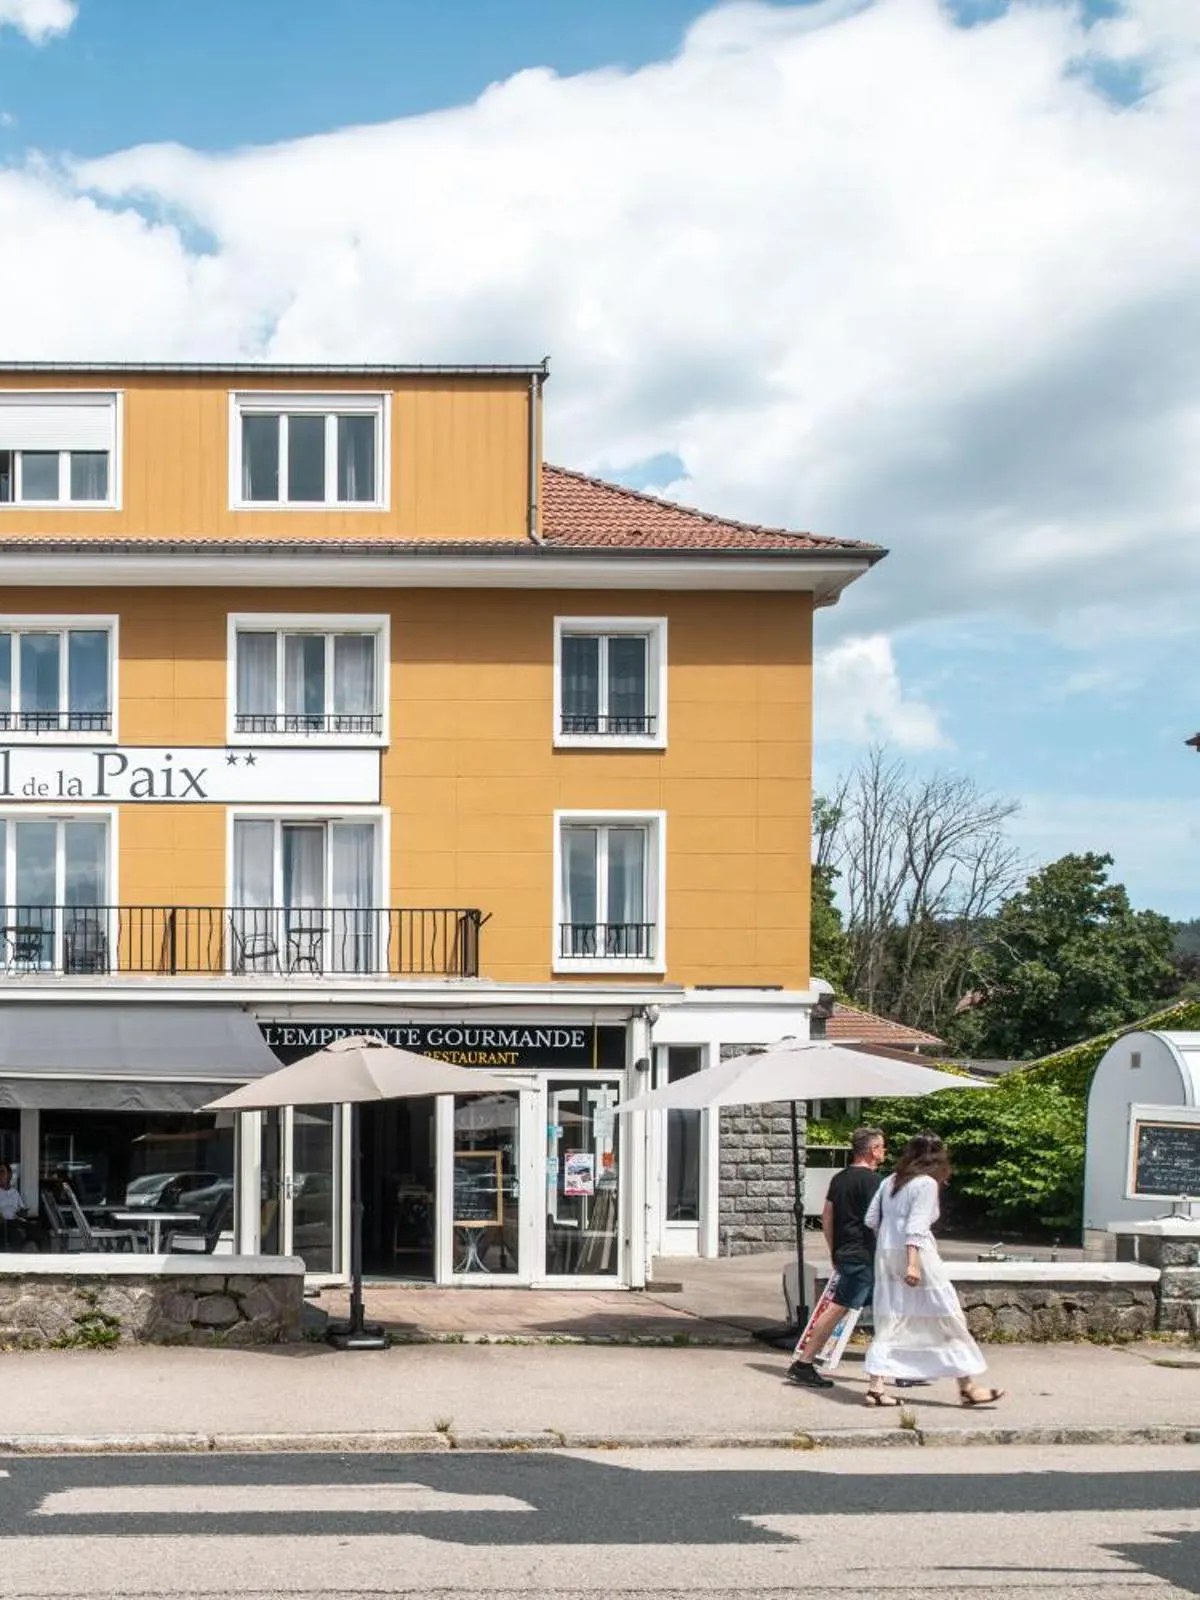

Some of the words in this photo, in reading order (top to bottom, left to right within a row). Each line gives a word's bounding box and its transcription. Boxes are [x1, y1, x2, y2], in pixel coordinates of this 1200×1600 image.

[22, 776, 49, 797] de
[56, 770, 83, 797] la
[91, 751, 209, 799] Paix
[426, 1028, 585, 1048] GOURMANDE
